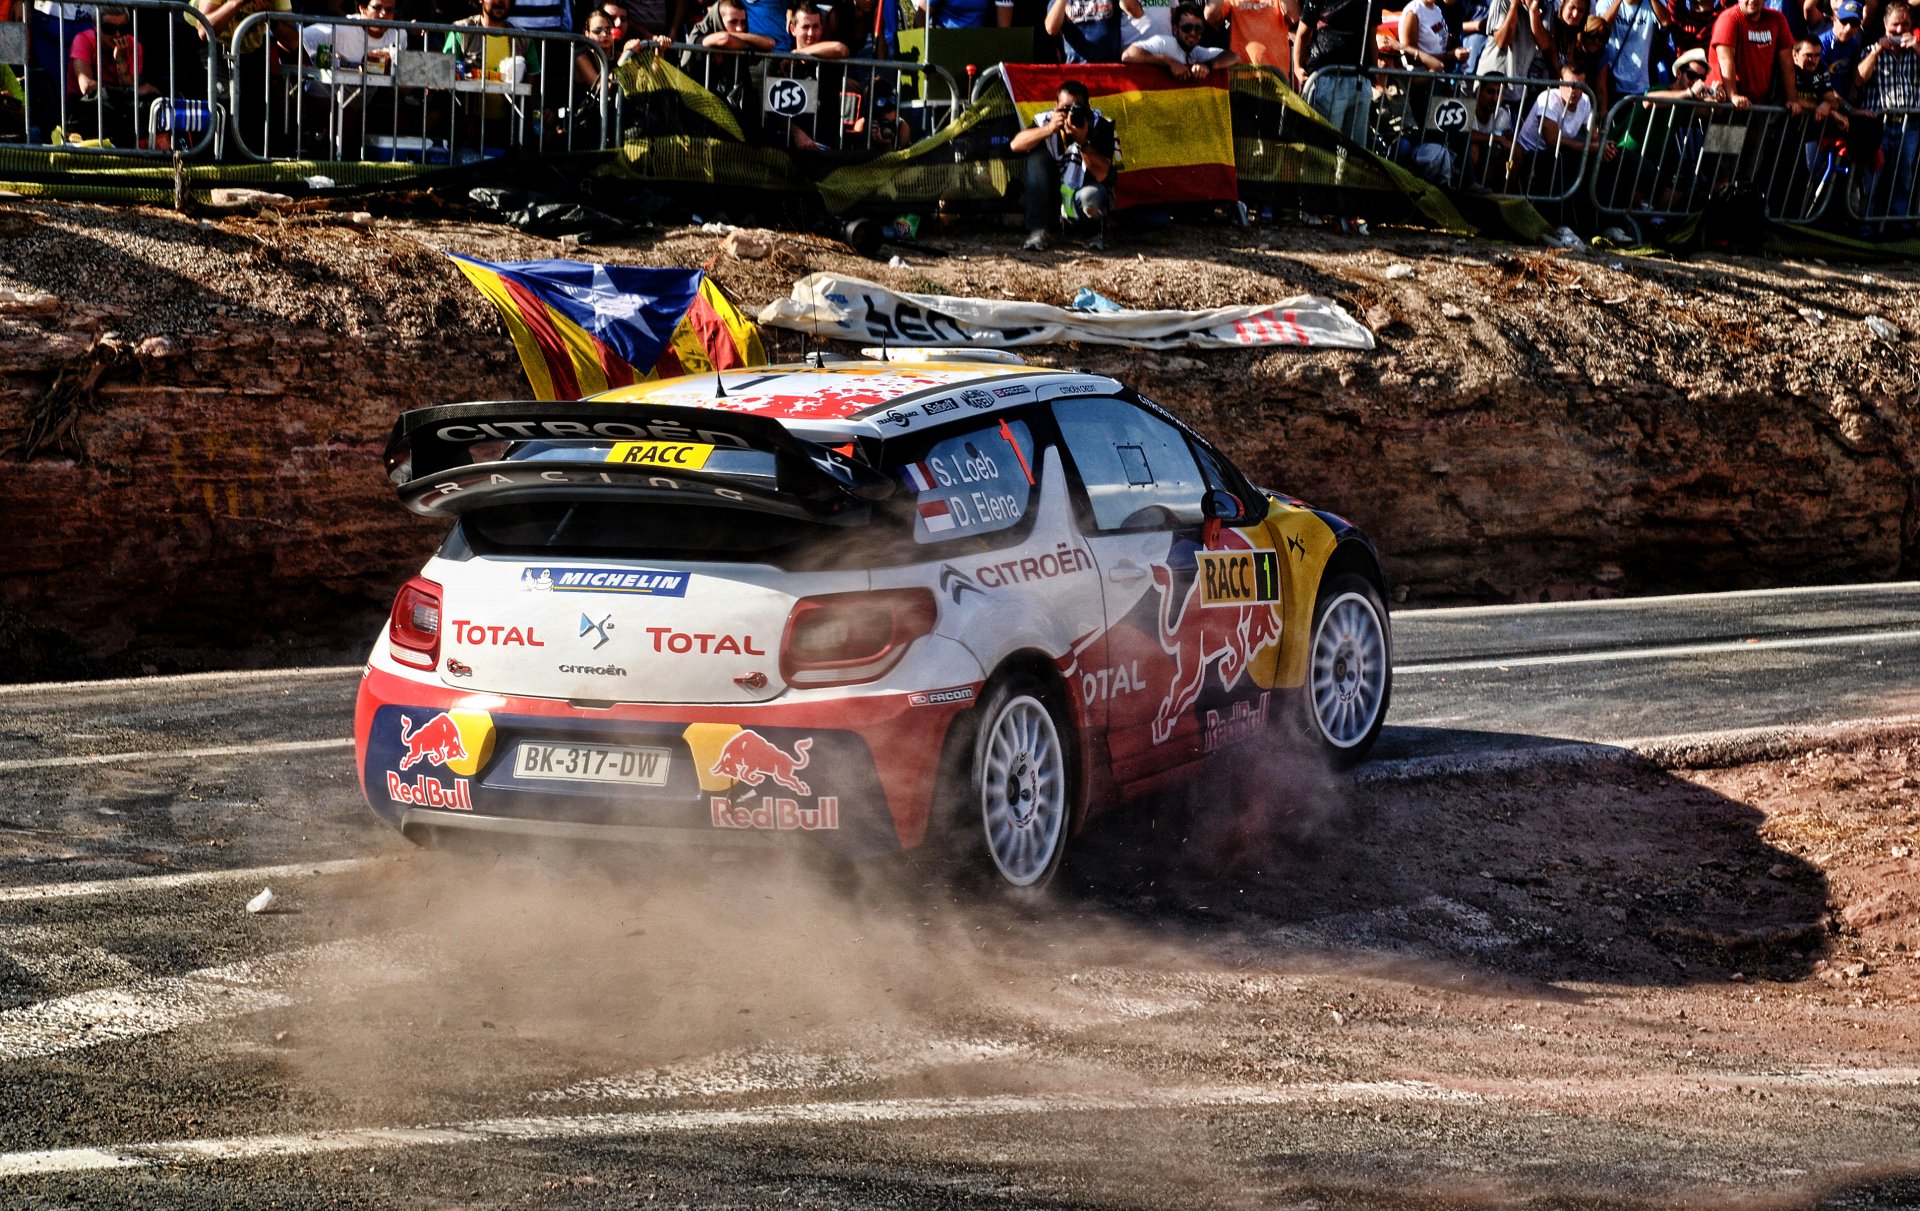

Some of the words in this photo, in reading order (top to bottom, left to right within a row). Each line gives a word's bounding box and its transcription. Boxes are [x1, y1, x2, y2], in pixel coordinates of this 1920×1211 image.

[436, 418, 748, 448] CITROËN
[622, 445, 694, 464] RACC
[931, 457, 957, 488] S.
[950, 450, 999, 484] Loeb
[950, 495, 976, 528] D.
[971, 491, 1021, 523] Elena
[558, 571, 683, 590] MICHELIN
[976, 543, 1093, 589] CITROËN
[1204, 556, 1251, 600] RACC
[1263, 553, 1271, 599] 1
[452, 619, 545, 647] TOTAL
[645, 627, 766, 657] TOTAL
[558, 664, 627, 677] CITROËN
[1079, 660, 1147, 706] OTAL
[929, 688, 973, 703] FACOM
[523, 744, 660, 779] BK-317-DW
[387, 770, 428, 807] Red
[425, 776, 474, 811] Bull
[710, 796, 775, 829] Red
[775, 796, 839, 831] Bull
